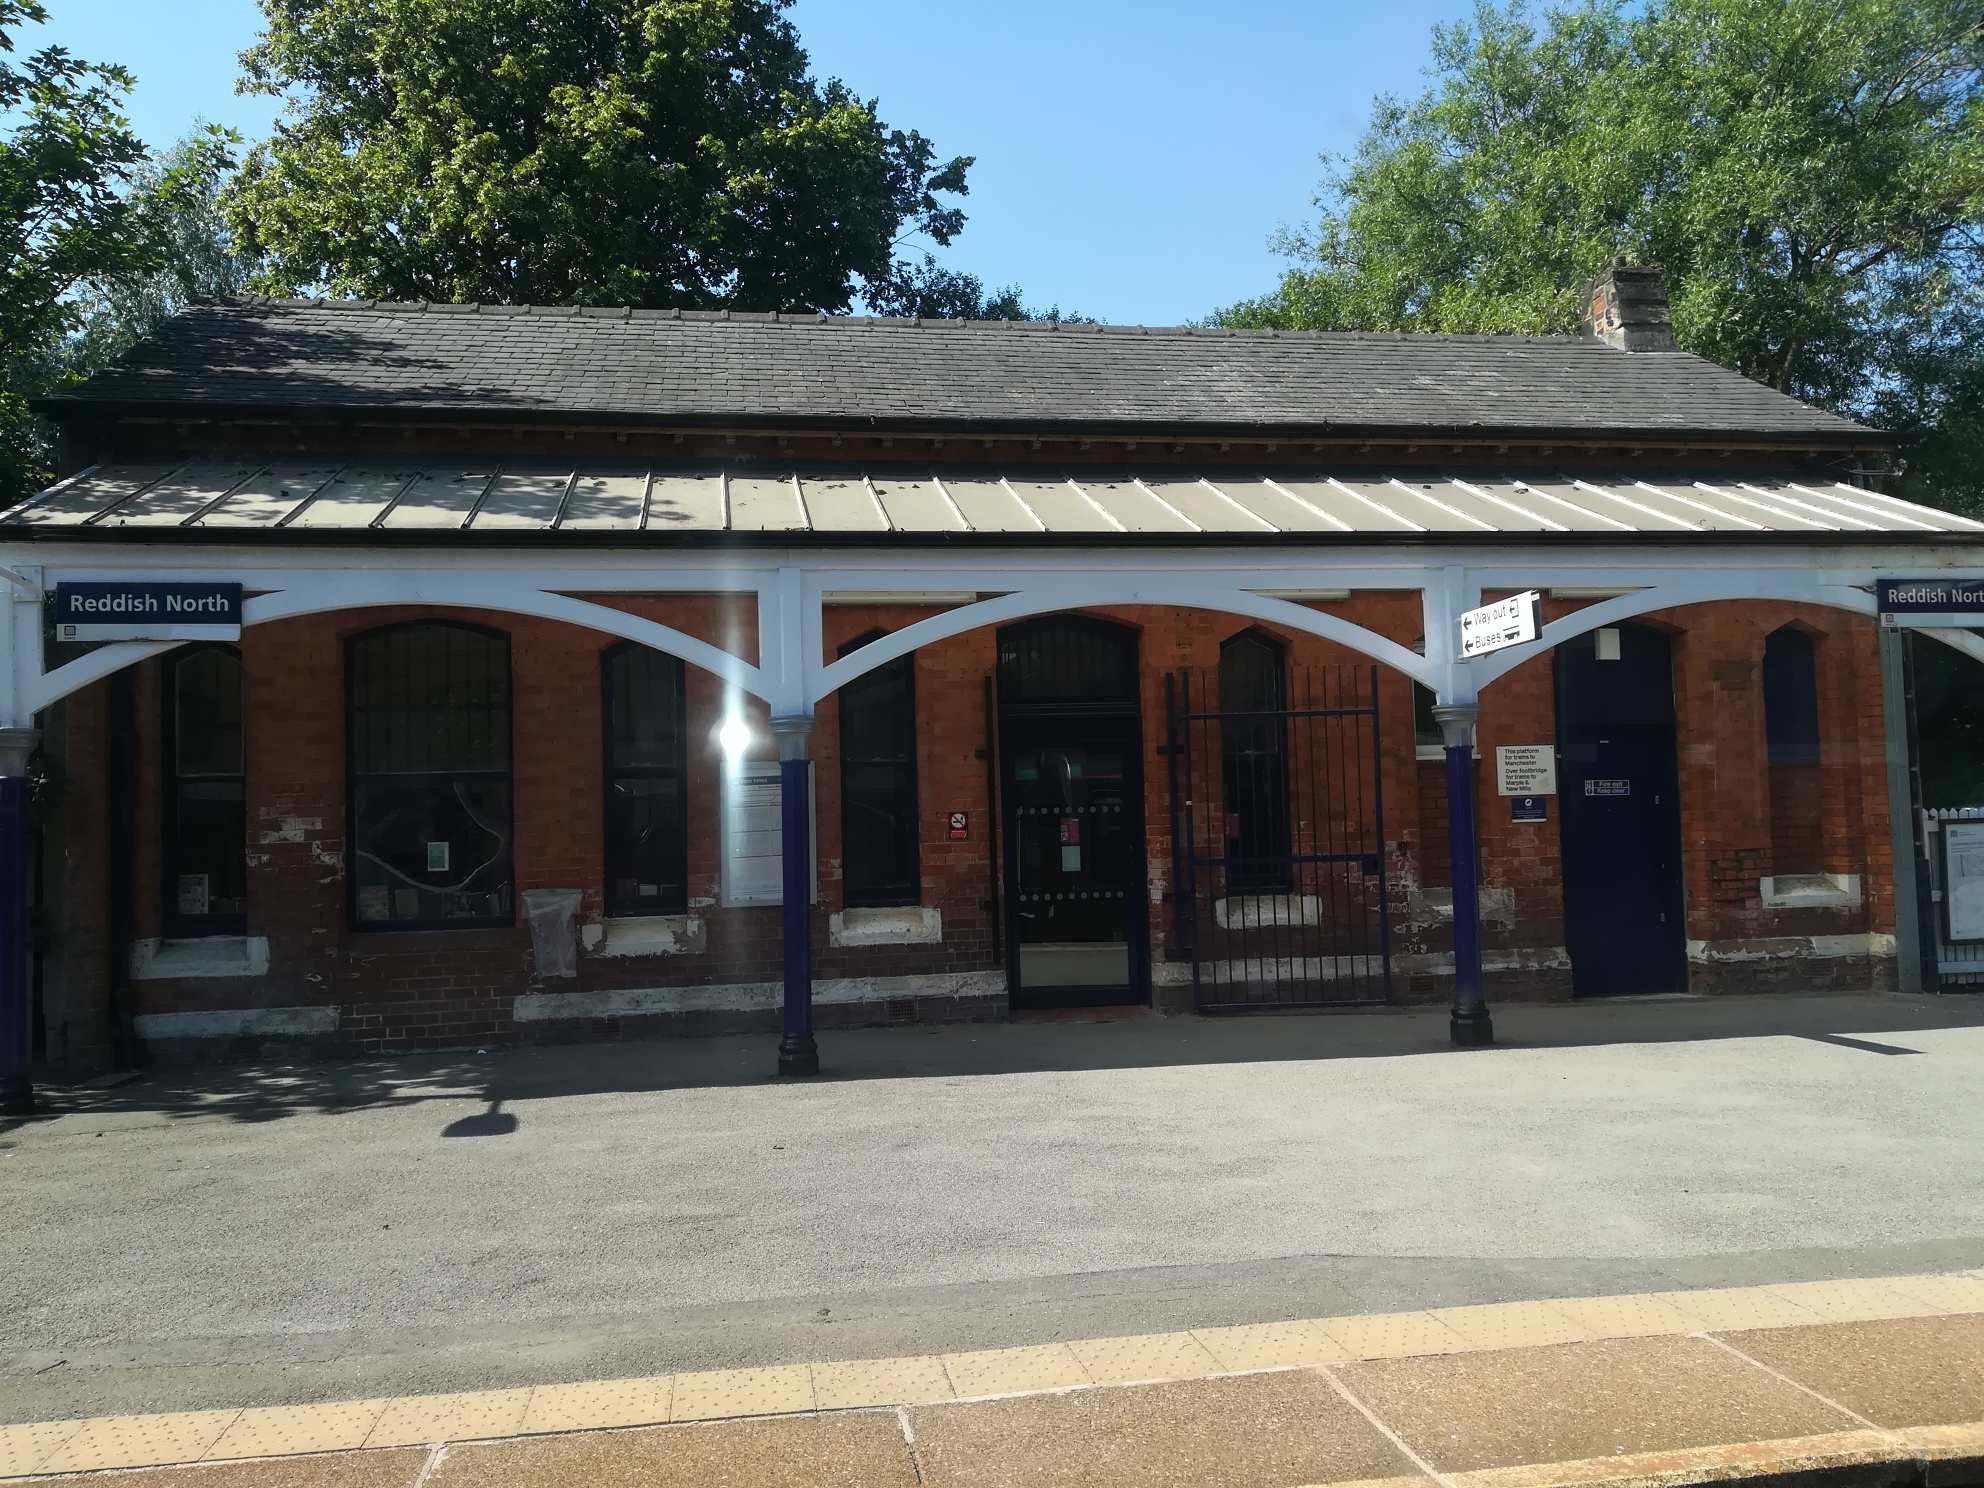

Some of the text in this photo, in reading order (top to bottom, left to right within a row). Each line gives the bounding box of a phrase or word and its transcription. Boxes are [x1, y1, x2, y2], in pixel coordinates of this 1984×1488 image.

[70, 594, 229, 612] Reddish North
[1888, 588, 1947, 603] Reddish
[1473, 604, 1506, 625] Way out
[1475, 632, 1501, 648] Buses
[1519, 767, 1548, 775] footbridge
